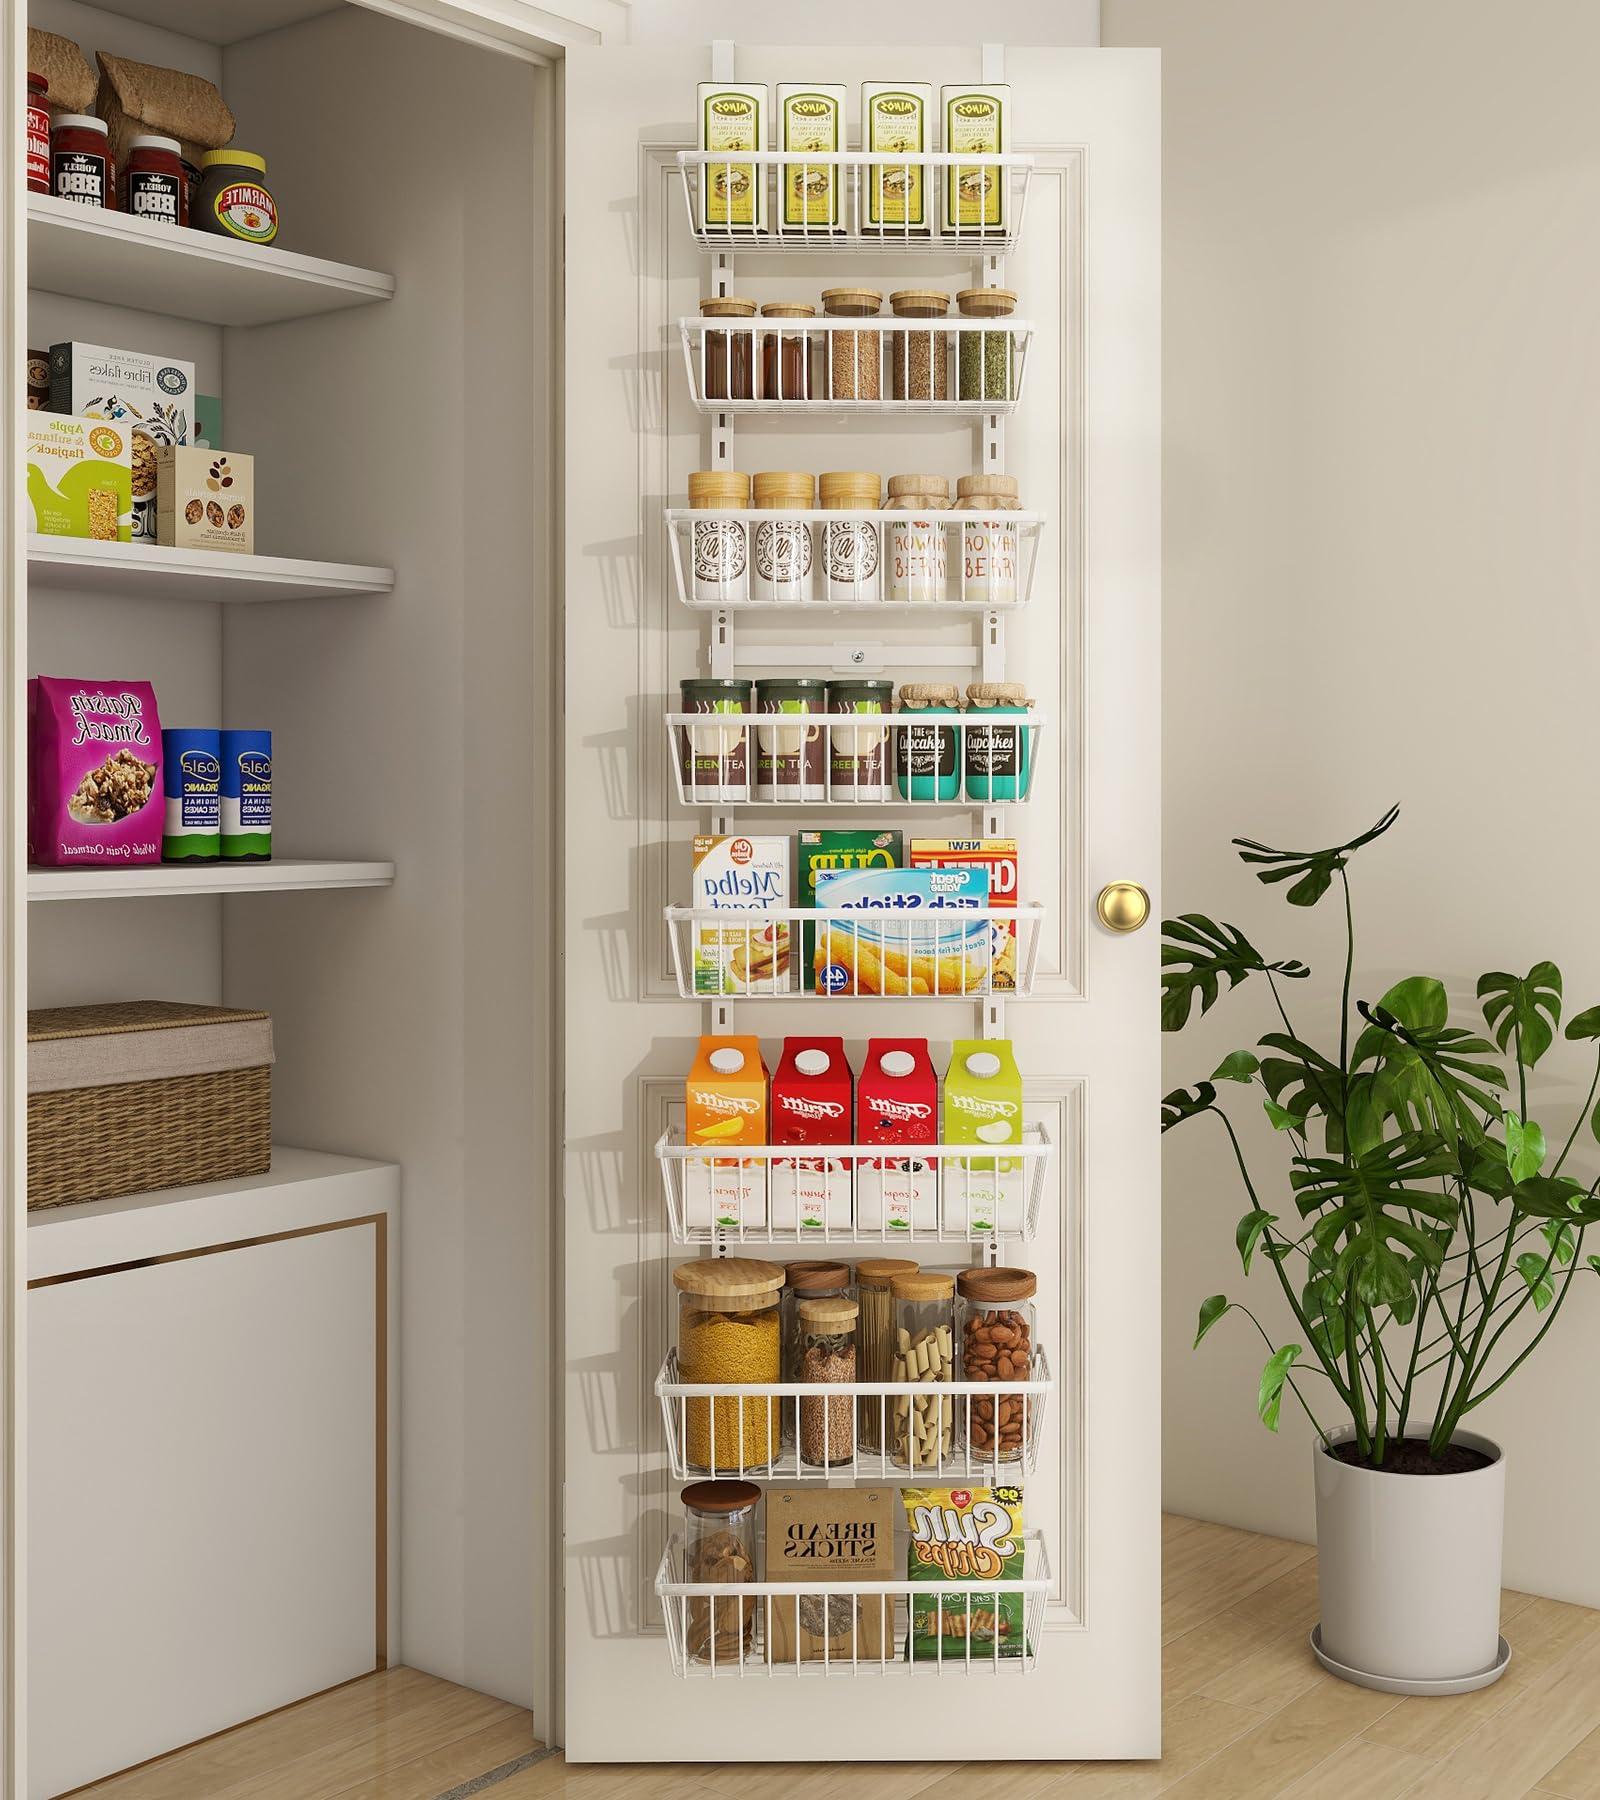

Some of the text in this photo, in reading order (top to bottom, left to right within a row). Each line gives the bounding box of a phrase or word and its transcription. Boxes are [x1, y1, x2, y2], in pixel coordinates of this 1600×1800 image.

[685, 760, 745, 769] GEEN TEA
[759, 760, 785, 769] REN
[833, 760, 860, 769] REE
